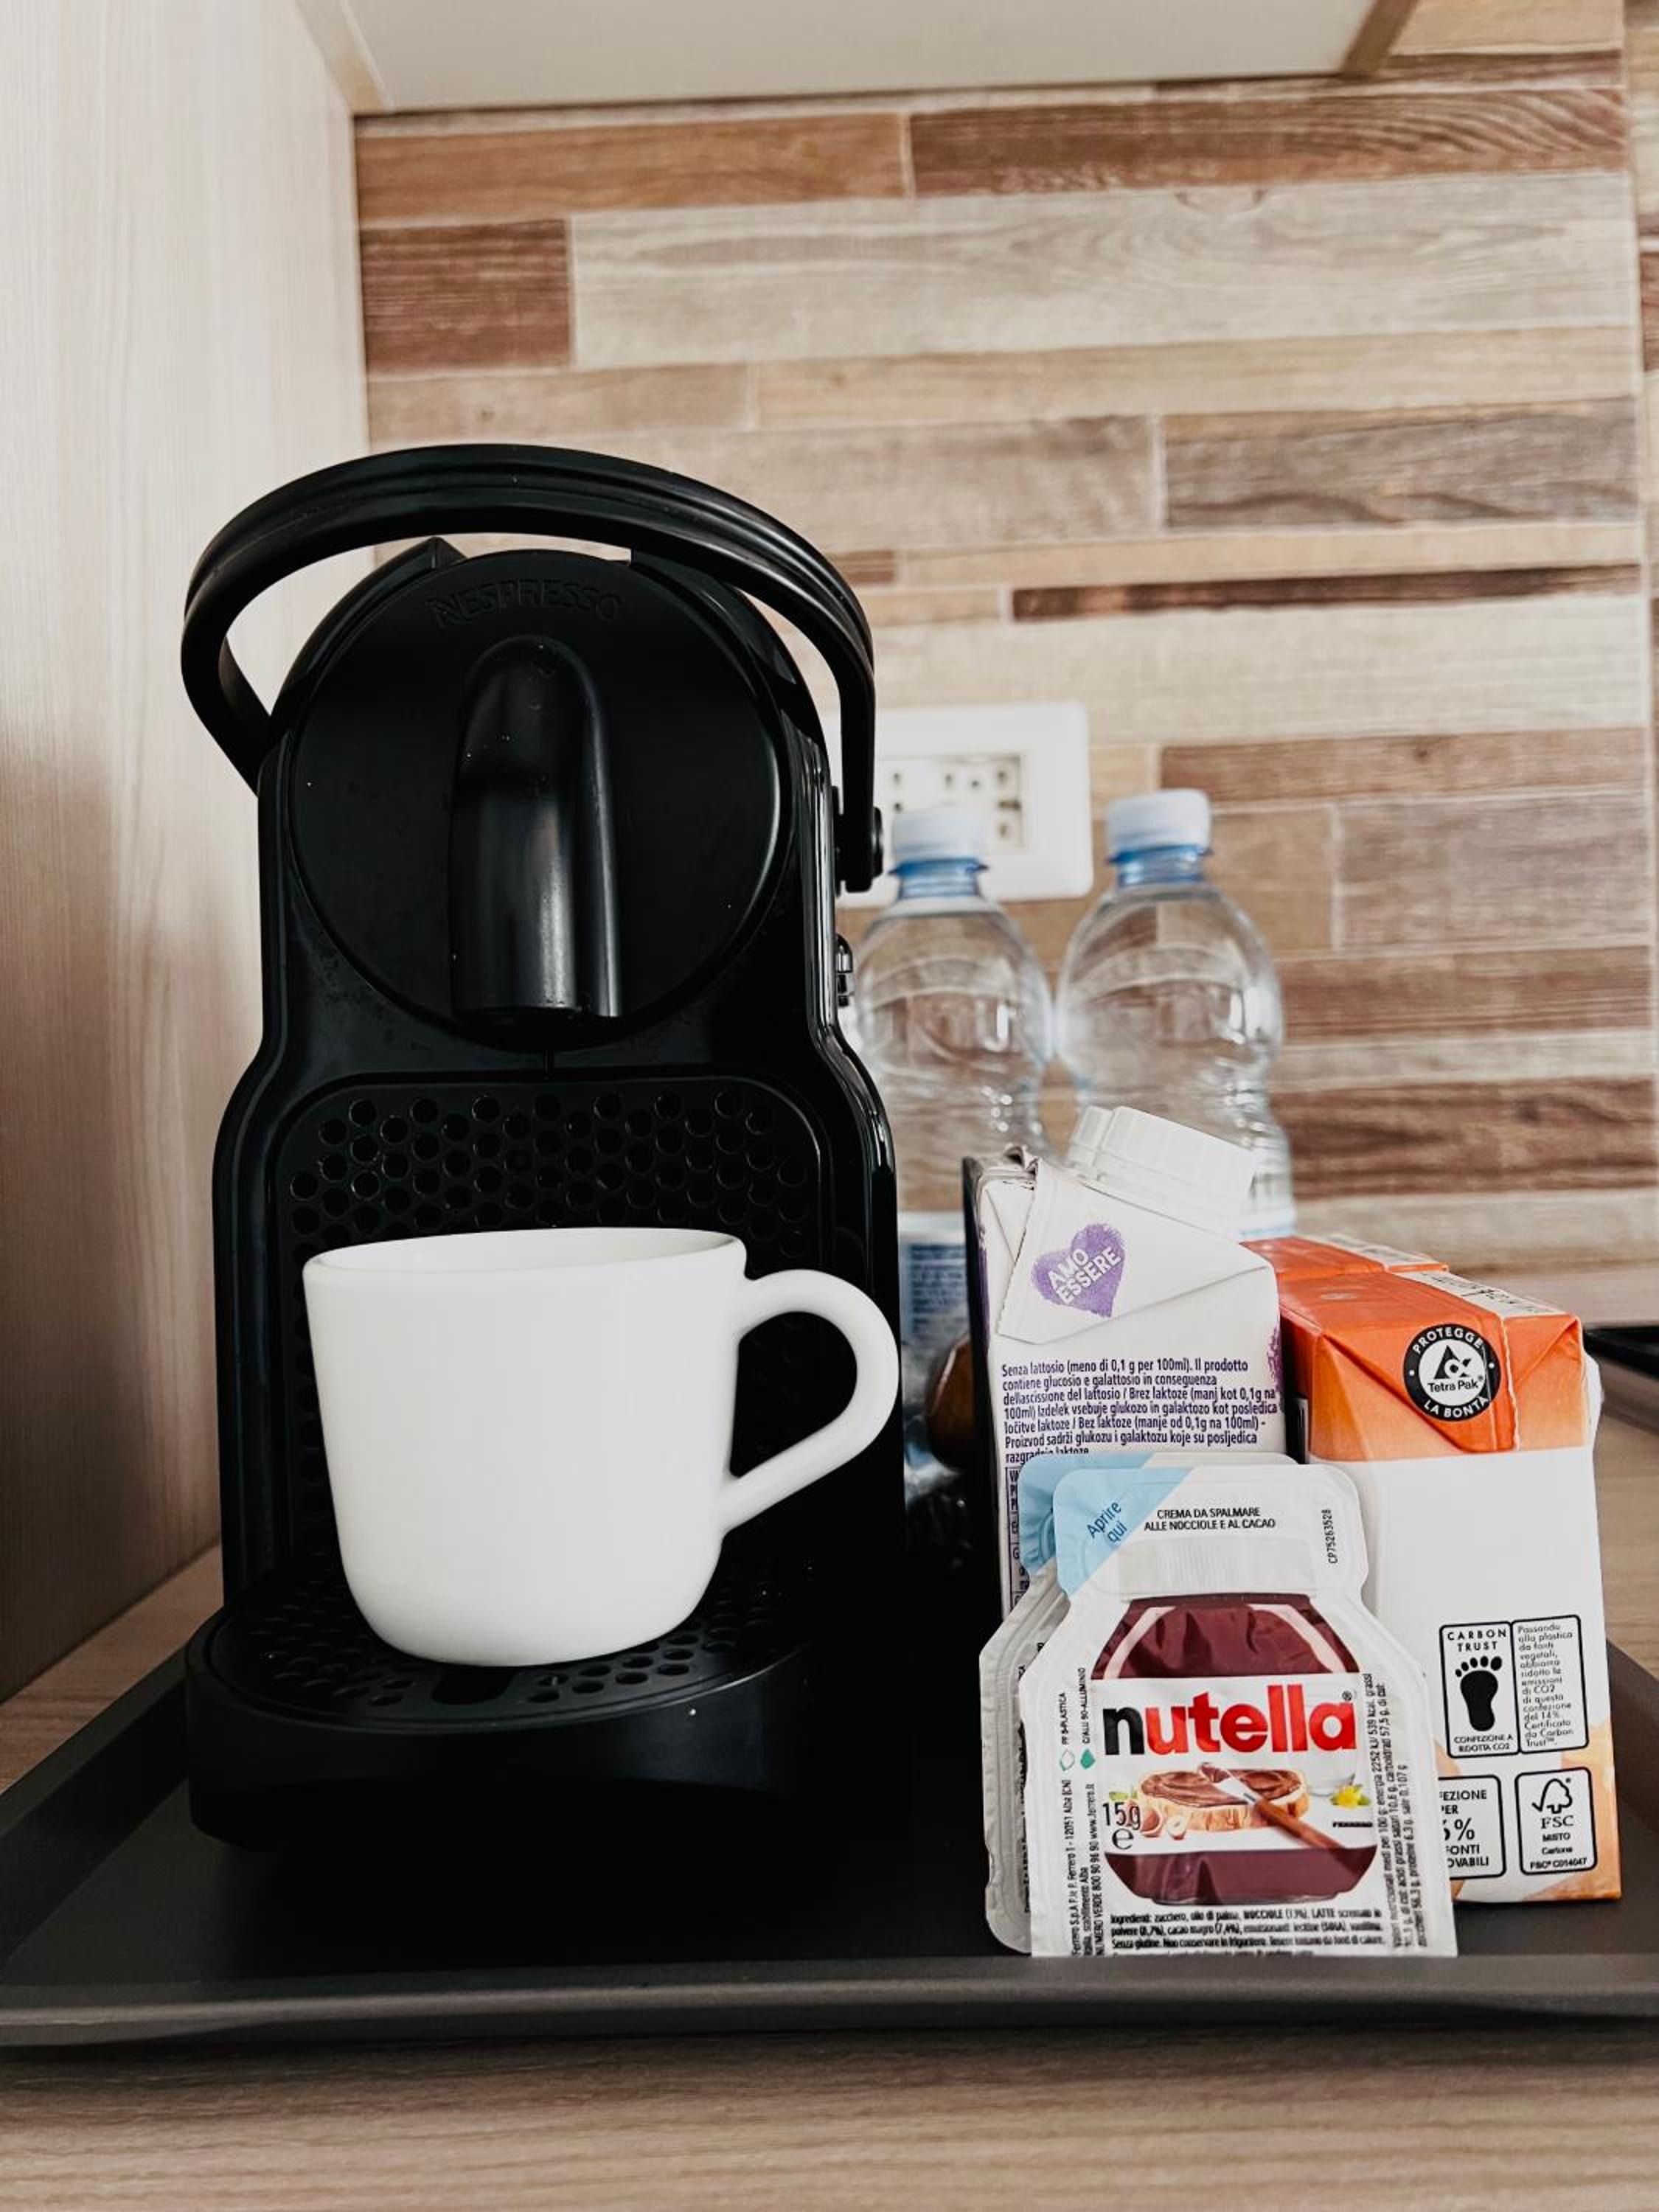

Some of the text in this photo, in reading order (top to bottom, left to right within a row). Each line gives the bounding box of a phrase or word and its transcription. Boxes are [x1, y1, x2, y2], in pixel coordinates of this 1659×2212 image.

[425, 578, 622, 627] NESPRESSO
[1048, 1248, 1090, 1290] AMO
[1056, 1246, 1121, 1304] ESSERE
[1412, 1326, 1484, 1354] PROTEGGE
[1002, 1364, 1028, 1377] Senza
[1030, 1360, 1065, 1374] lattosio
[1067, 1360, 1096, 1374] (meno
[1099, 1358, 1108, 1371] di
[1111, 1359, 1125, 1372] 0,1
[1129, 1361, 1135, 1374] g
[1138, 1360, 1154, 1374] per
[1195, 1357, 1201, 1371] Il
[1204, 1357, 1248, 1374] prodotto
[1003, 1372, 1217, 1392] contiene glucosio e galattosio in conseguenza
[1427, 1379, 1479, 1393] Tetra Pak
[1067, 1388, 1082, 1401] del
[1085, 1387, 1121, 1400] lattosio
[1130, 1387, 1150, 1400] Brez
[1152, 1387, 1188, 1400] laktoze
[1191, 1387, 1217, 1402] (manj
[1220, 1387, 1237, 1400] kot
[1239, 1387, 1262, 1402] 0,1g
[1265, 1388, 1276, 1399] na
[1004, 1401, 1278, 1420] 100ml) Izdelek vsebuje glukozo in galaktozo kot posledica
[1424, 1399, 1439, 1416] LA
[1037, 1418, 1070, 1431] laktoze
[1079, 1417, 1095, 1429] Bez
[1097, 1416, 1132, 1429] laktoze
[1135, 1416, 1167, 1431] (manje
[1170, 1416, 1183, 1429] od
[1185, 1416, 1207, 1432] 0,1g
[1210, 1419, 1222, 1429] na
[1225, 1416, 1259, 1431] 100ml)
[1005, 1434, 1045, 1449] Proizvod
[1076, 1430, 1113, 1447] glukozu
[1114, 1430, 1118, 1443] i
[1120, 1430, 1167, 1446] galaktozu
[1169, 1430, 1191, 1447] koje
[1194, 1433, 1205, 1443] su
[1207, 1430, 1257, 1447] posljedica
[1086, 1501, 1121, 1539] Aprire
[1157, 1507, 1261, 1519] CREMA DA SPALMARE
[1107, 1521, 1127, 1543] qui
[1144, 1518, 1276, 1531] ALLE NOCCIOLE E AL CACAO
[1447, 1629, 1507, 1641] CARBON
[1457, 1641, 1498, 1652] TRUST
[1519, 1644, 1531, 1652] da
[1454, 1734, 1506, 1744] CONFEZIONE
[1540, 1815, 1574, 1829] FSC
